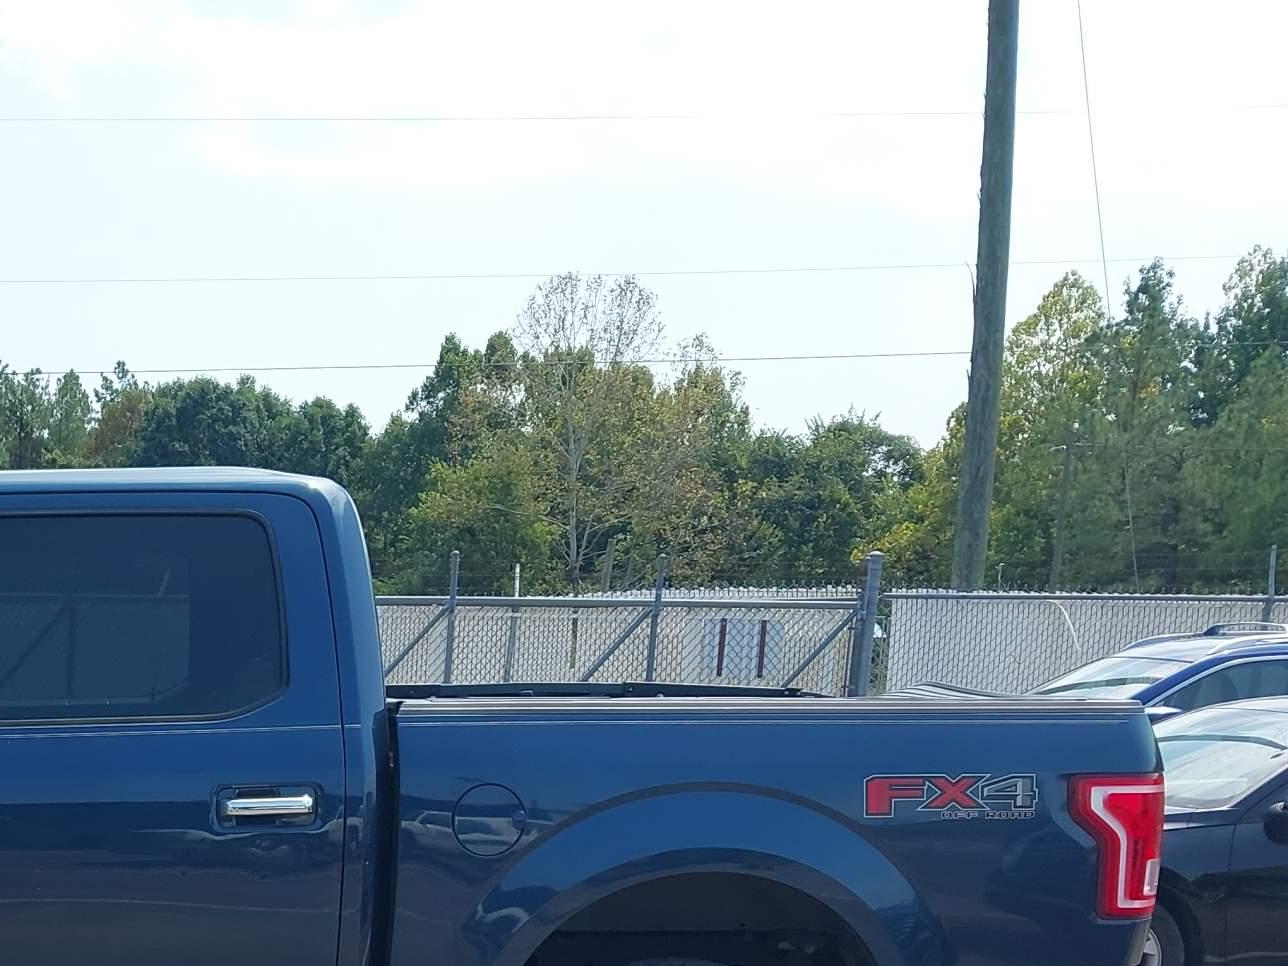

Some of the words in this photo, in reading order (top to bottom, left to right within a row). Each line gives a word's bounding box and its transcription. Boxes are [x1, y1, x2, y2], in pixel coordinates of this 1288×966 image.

[864, 774, 1038, 817] FX4
[941, 811, 979, 820] OFF
[984, 811, 1035, 820] ROAD
